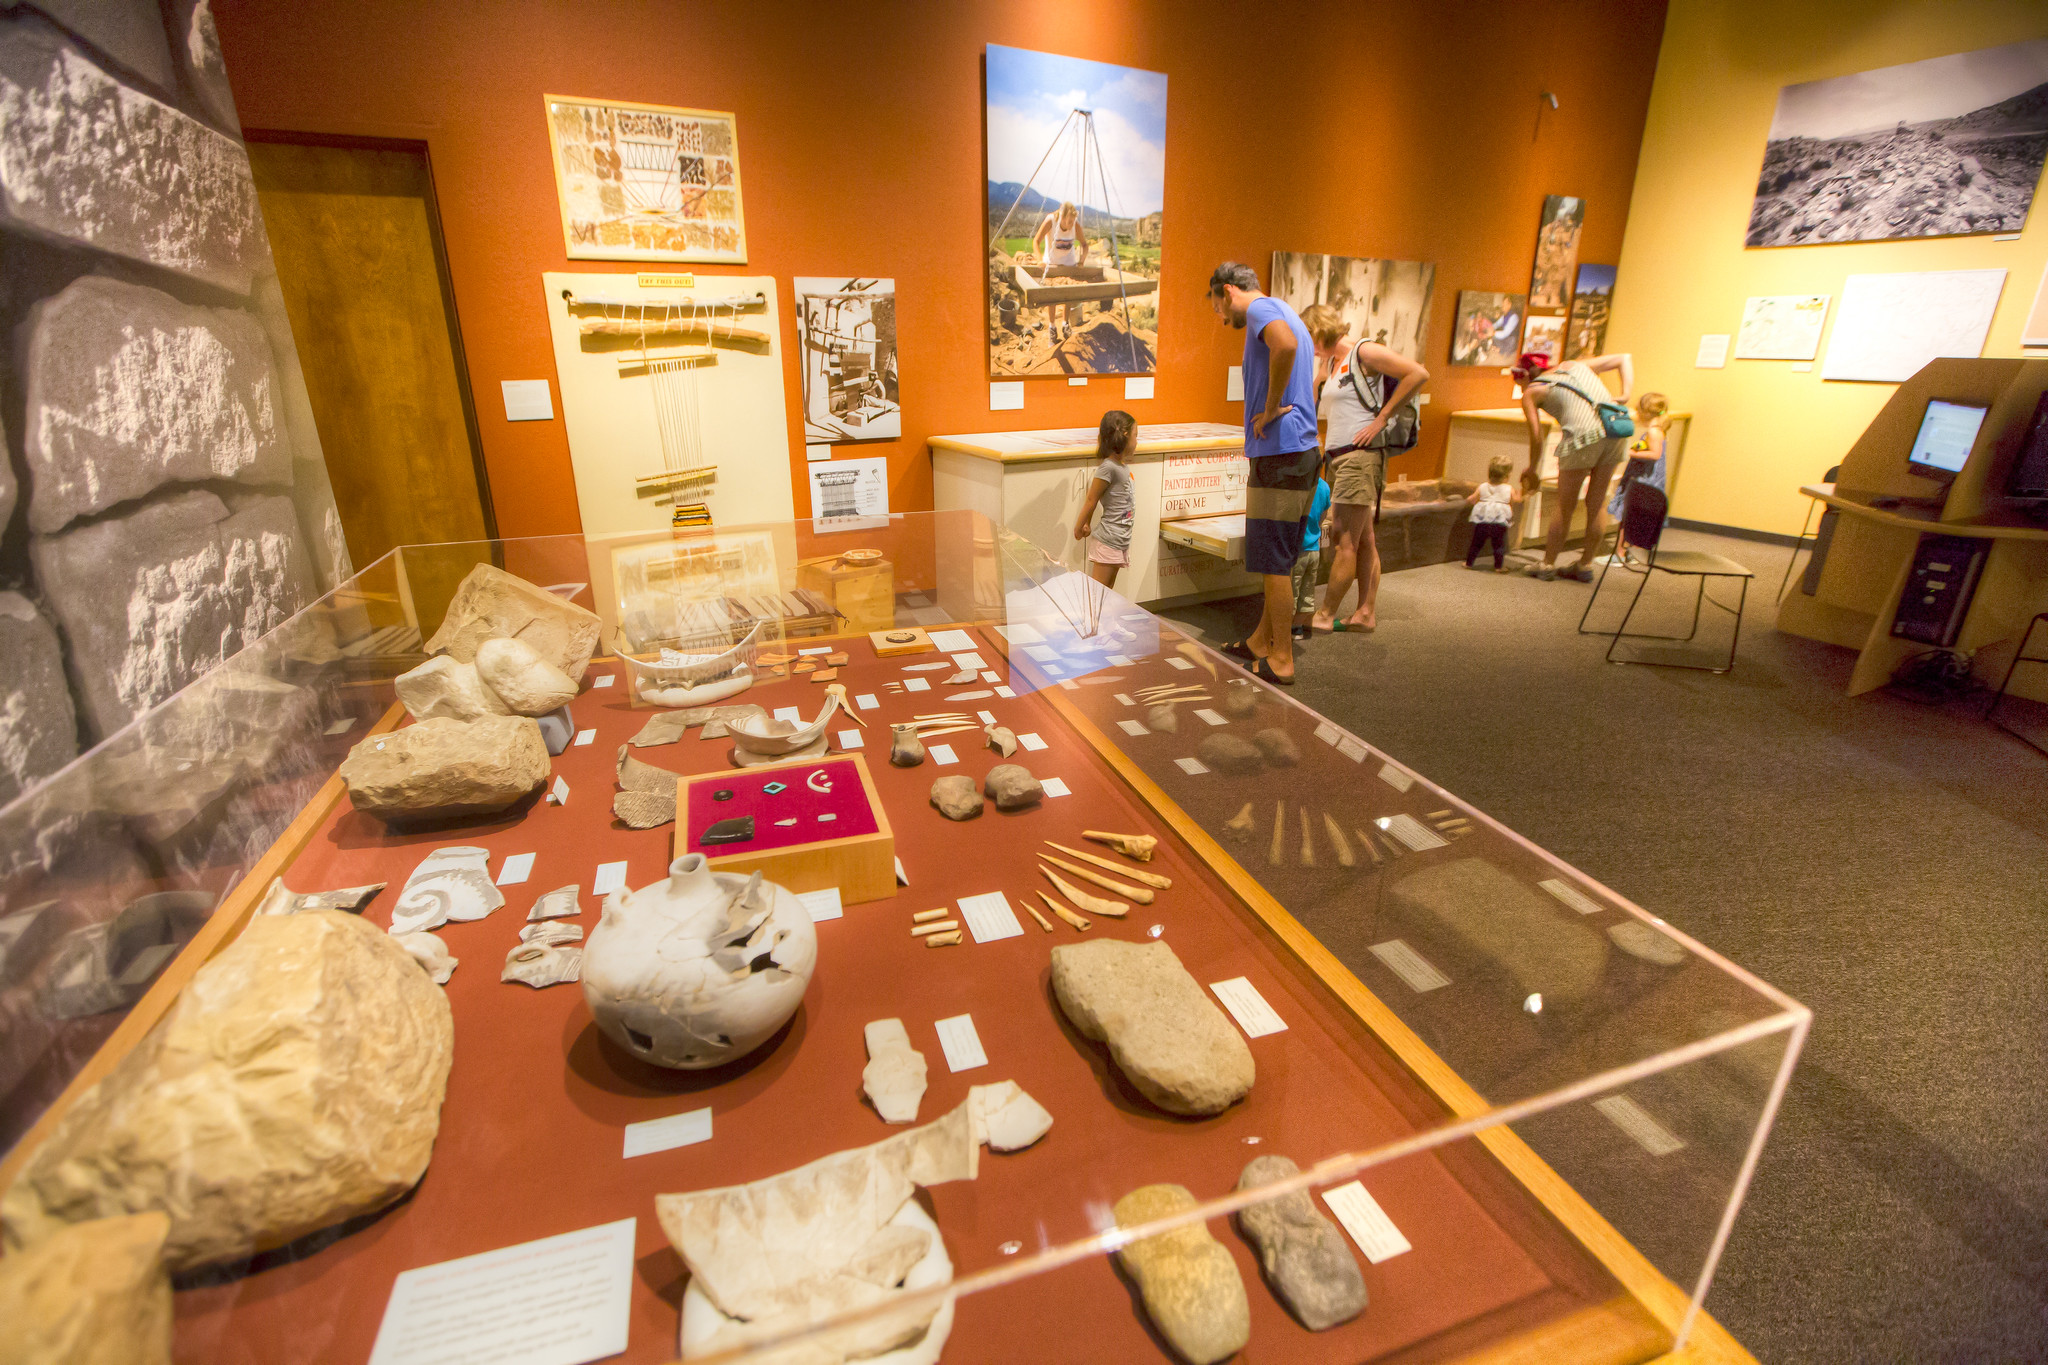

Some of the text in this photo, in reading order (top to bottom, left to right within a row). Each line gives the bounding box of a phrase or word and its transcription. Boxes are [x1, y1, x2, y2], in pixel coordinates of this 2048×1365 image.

[1169, 454, 1194, 467] PLAIN
[1196, 453, 1203, 465] &
[1164, 475, 1221, 490] PAINTED POTTERY
[1165, 496, 1207, 511] OPEN ME
